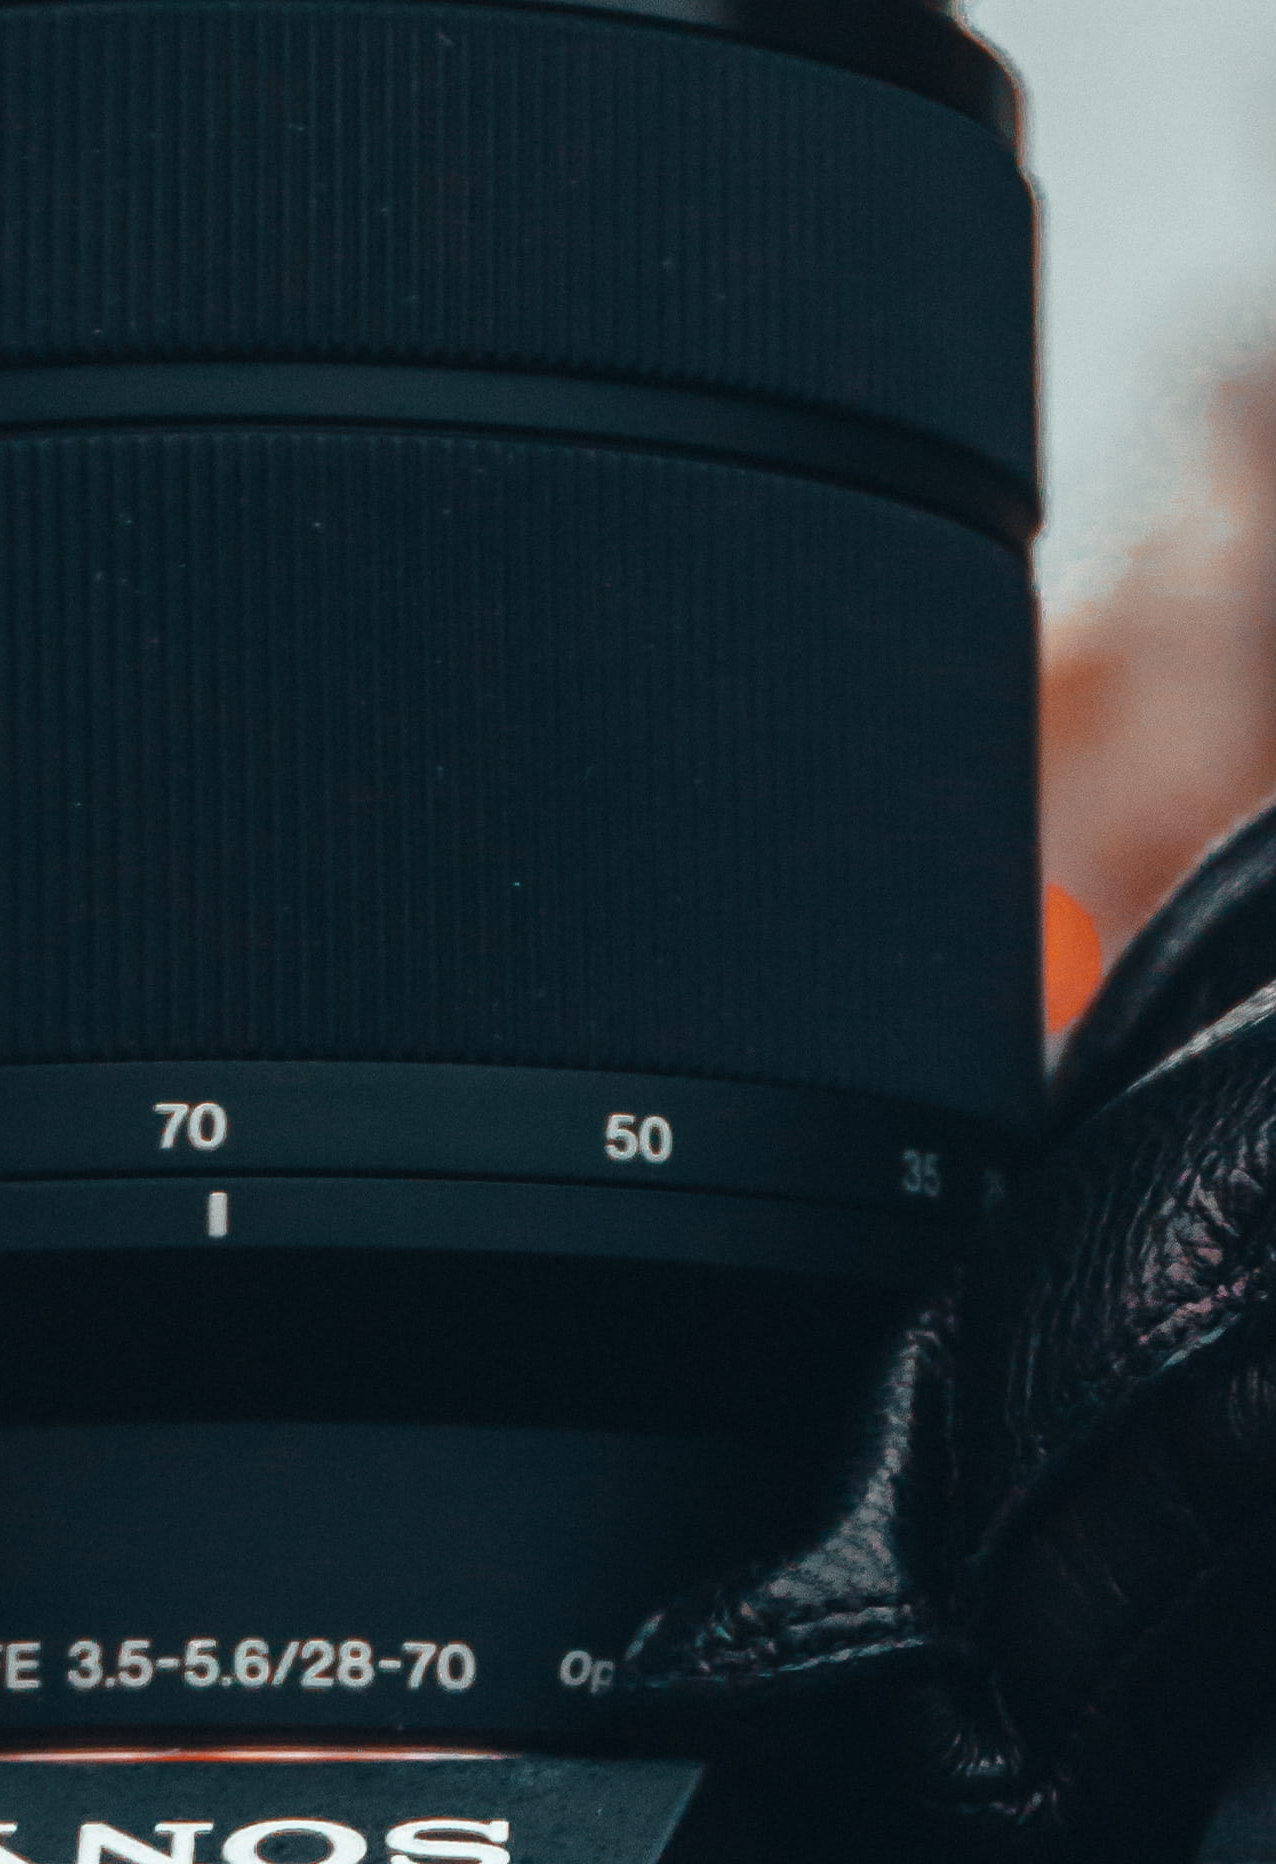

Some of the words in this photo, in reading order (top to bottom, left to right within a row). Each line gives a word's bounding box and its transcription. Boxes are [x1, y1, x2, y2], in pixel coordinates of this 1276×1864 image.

[152, 1100, 229, 1152] 70
[604, 1112, 674, 1164] 50
[901, 1148, 942, 1199] 35
[66, 1636, 477, 1692] 3.5-5.6/28-70
